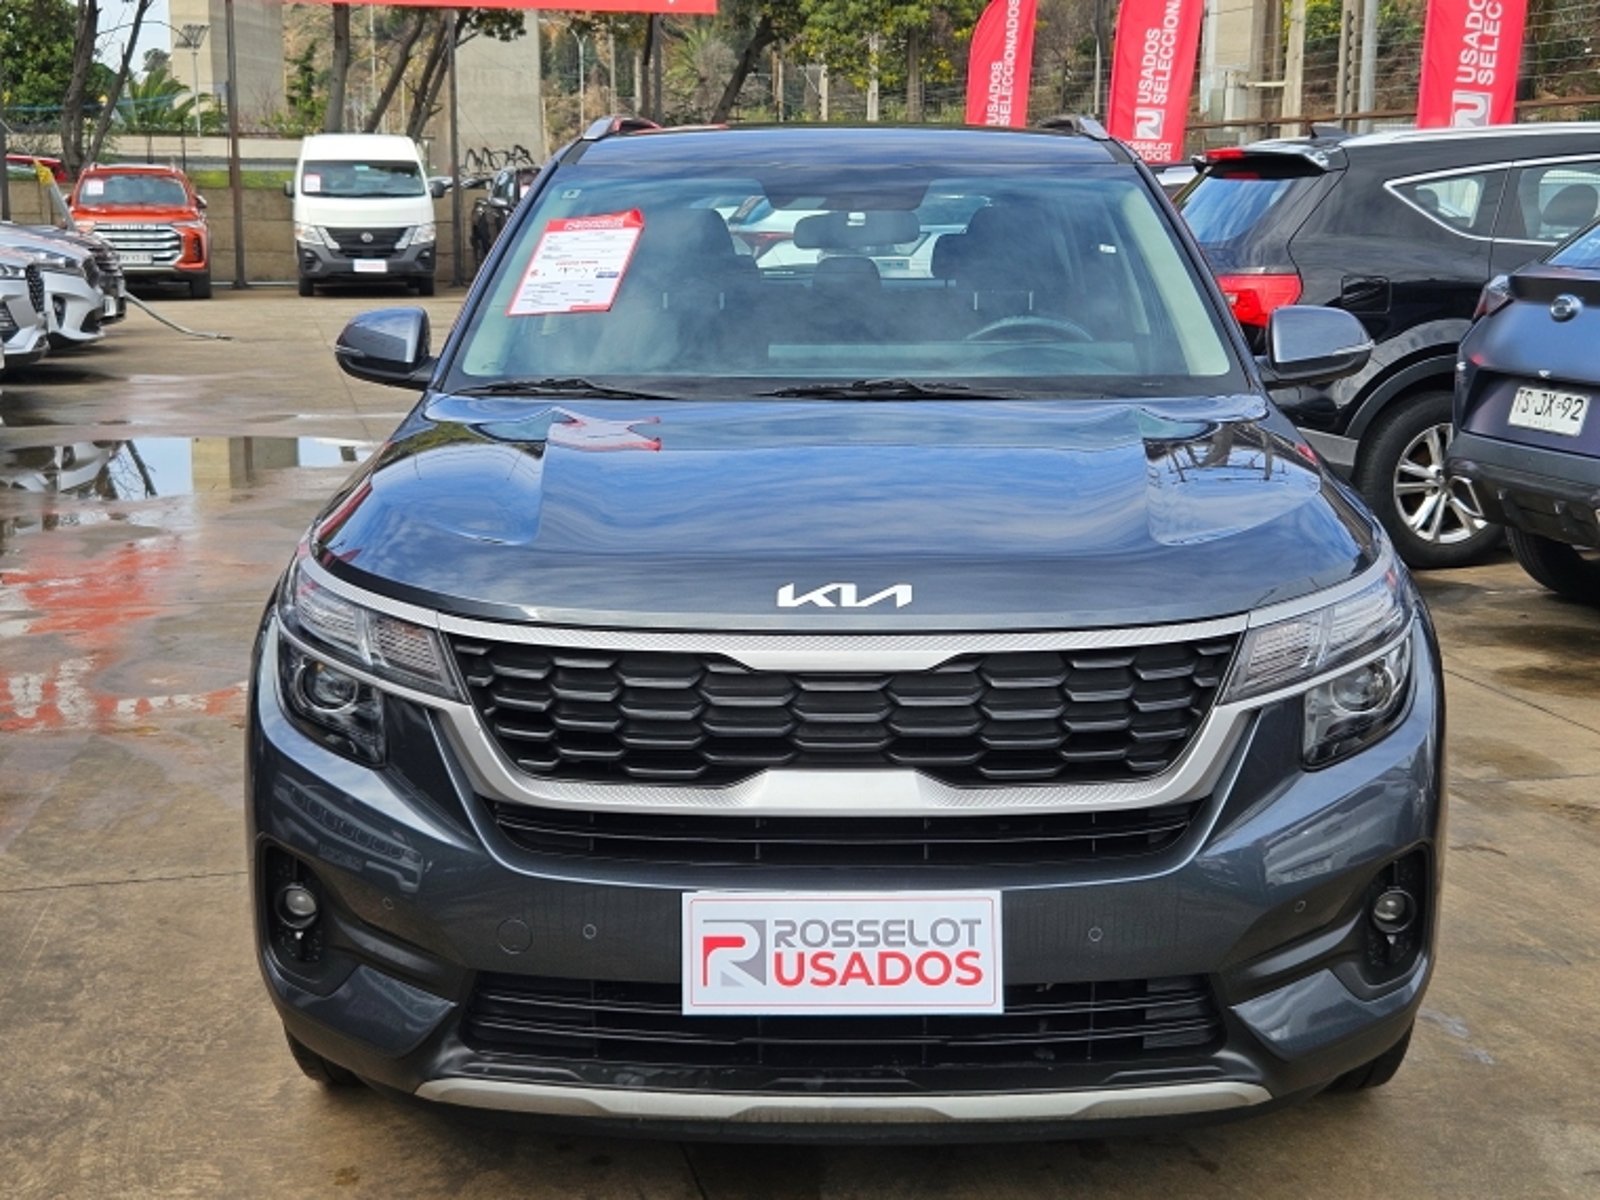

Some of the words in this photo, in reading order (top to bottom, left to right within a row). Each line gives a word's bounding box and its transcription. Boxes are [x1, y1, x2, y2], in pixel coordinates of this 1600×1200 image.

[1137, 28, 1161, 104] USADOS
[777, 582, 913, 608] KIA
[774, 918, 982, 948] ROSSELOT
[774, 951, 983, 987] USADOS
